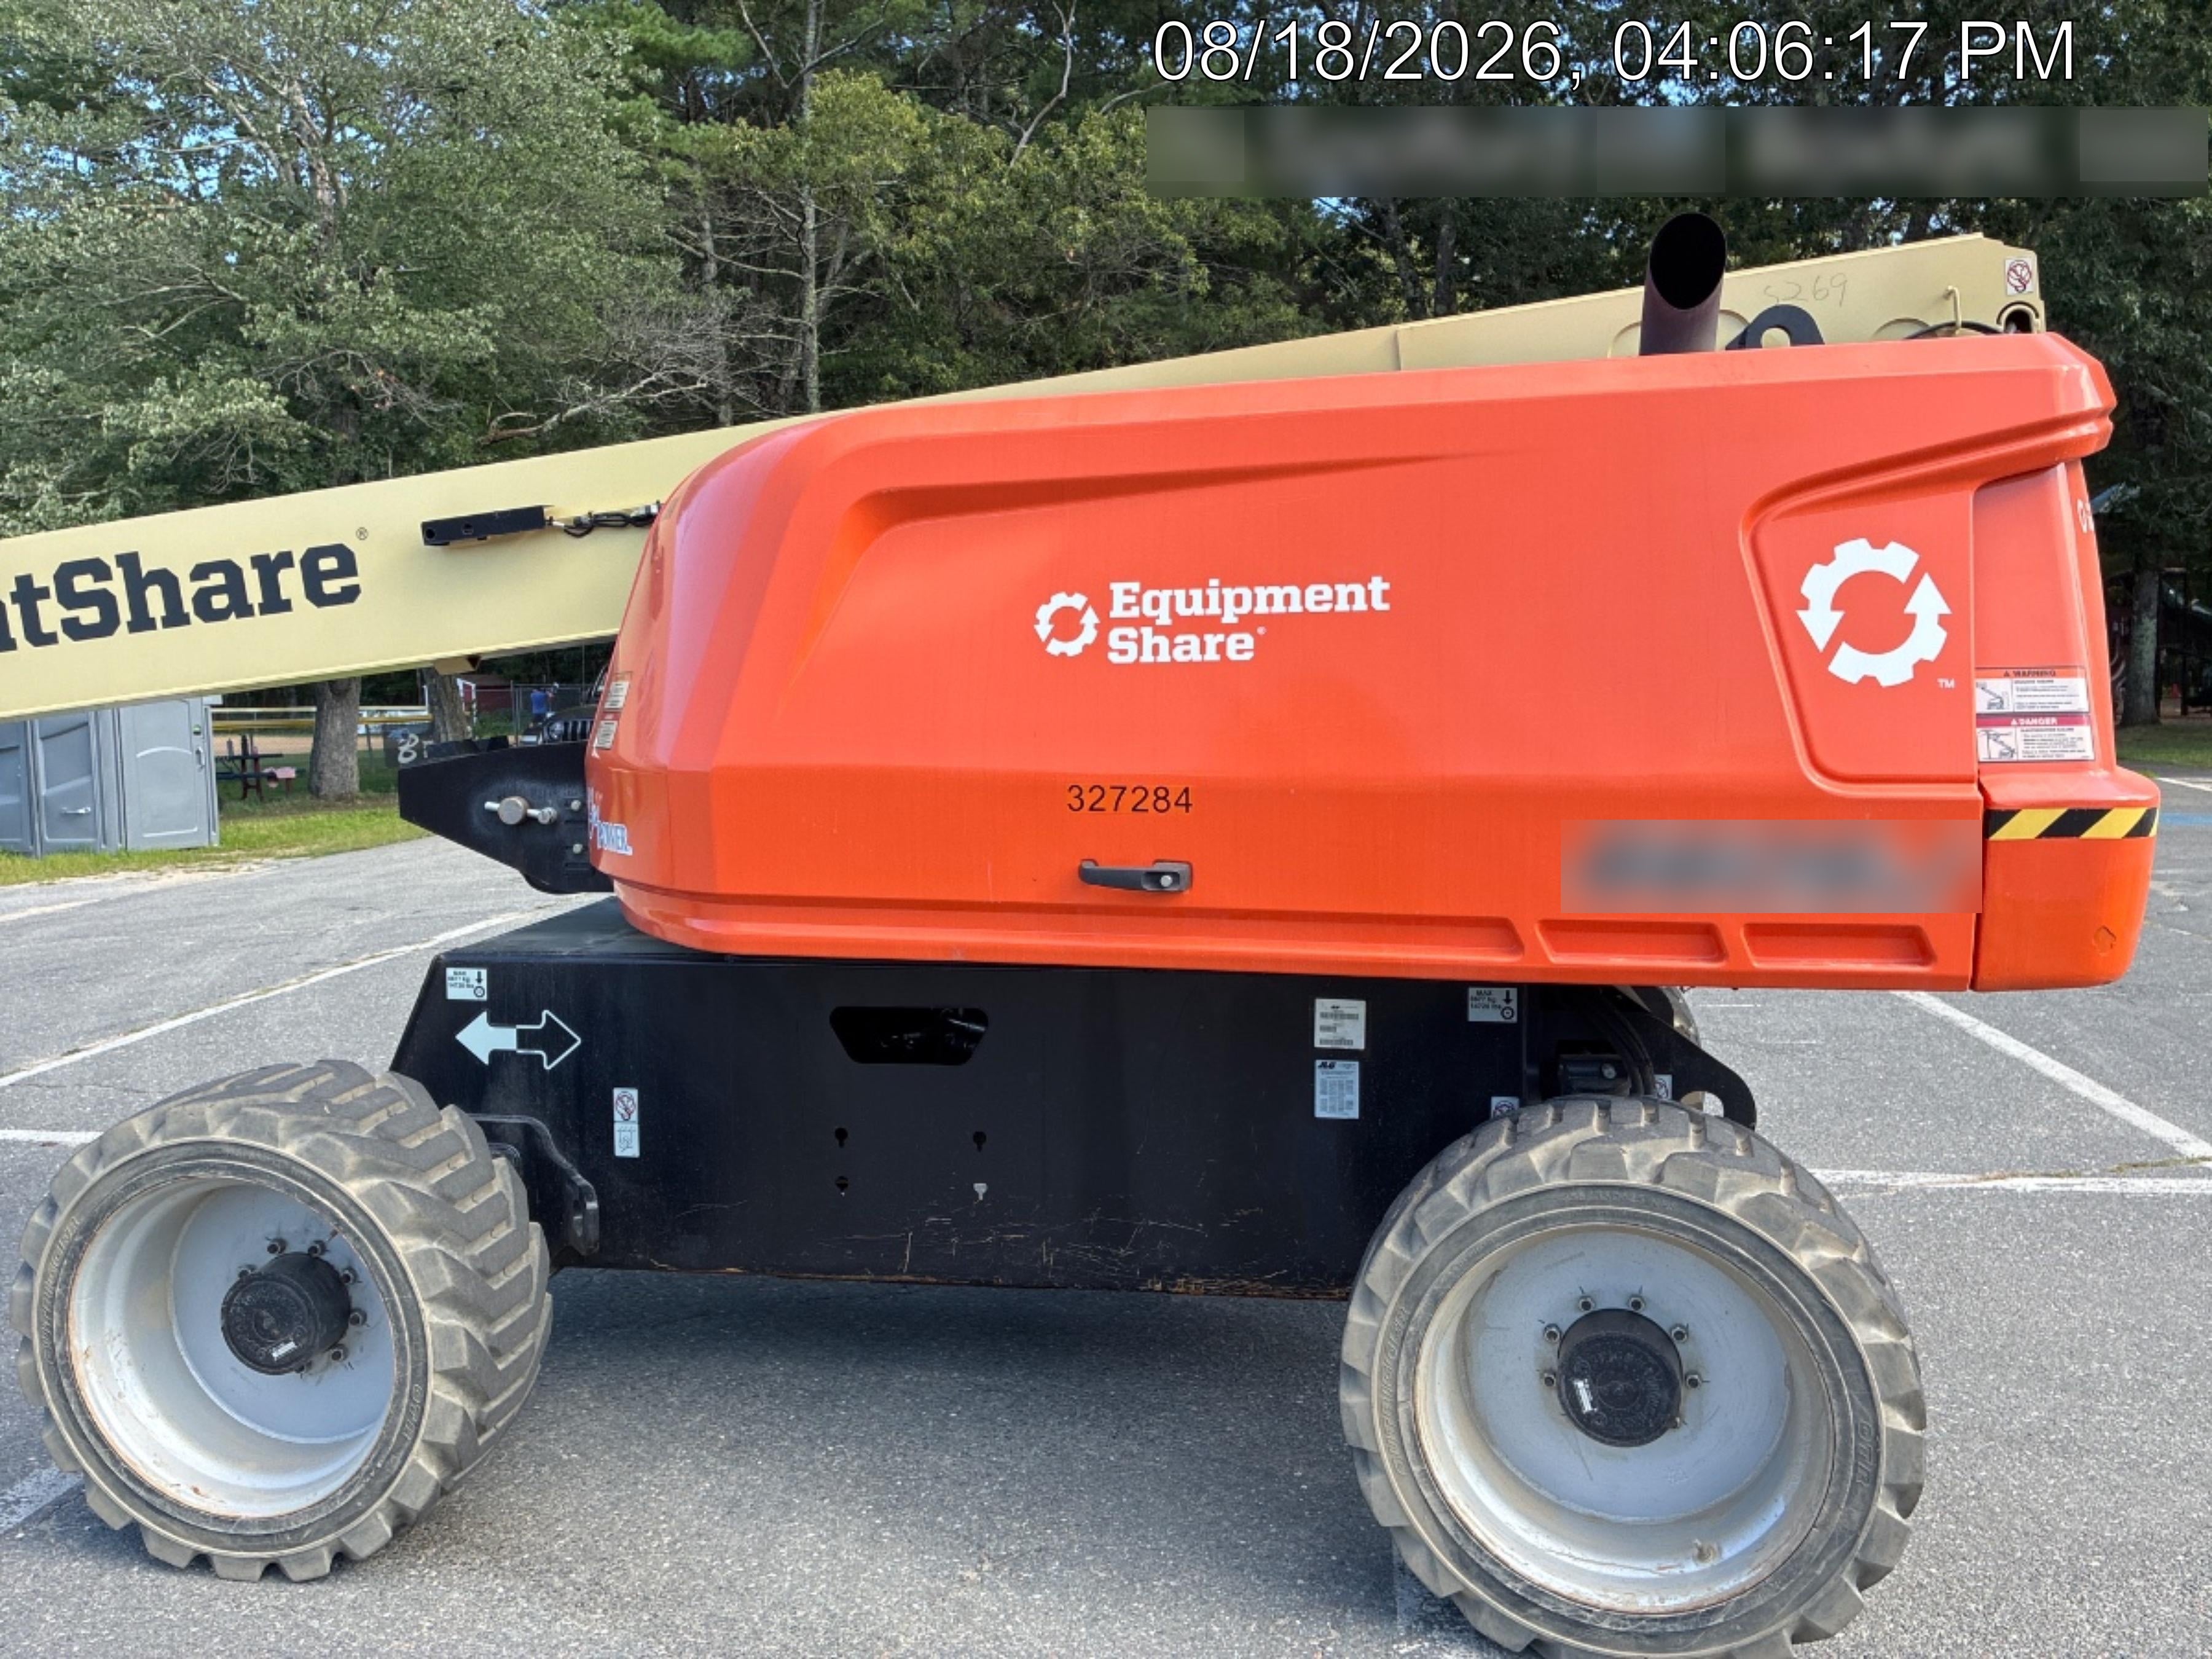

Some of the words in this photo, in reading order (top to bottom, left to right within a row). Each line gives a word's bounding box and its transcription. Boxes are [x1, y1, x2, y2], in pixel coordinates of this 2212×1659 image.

[0, 543, 361, 653] tShare
[1109, 576, 1390, 625] Equipment
[1108, 626, 1255, 664] Share
[1937, 678, 1955, 689] TM
[1067, 784, 1193, 814] 327284
